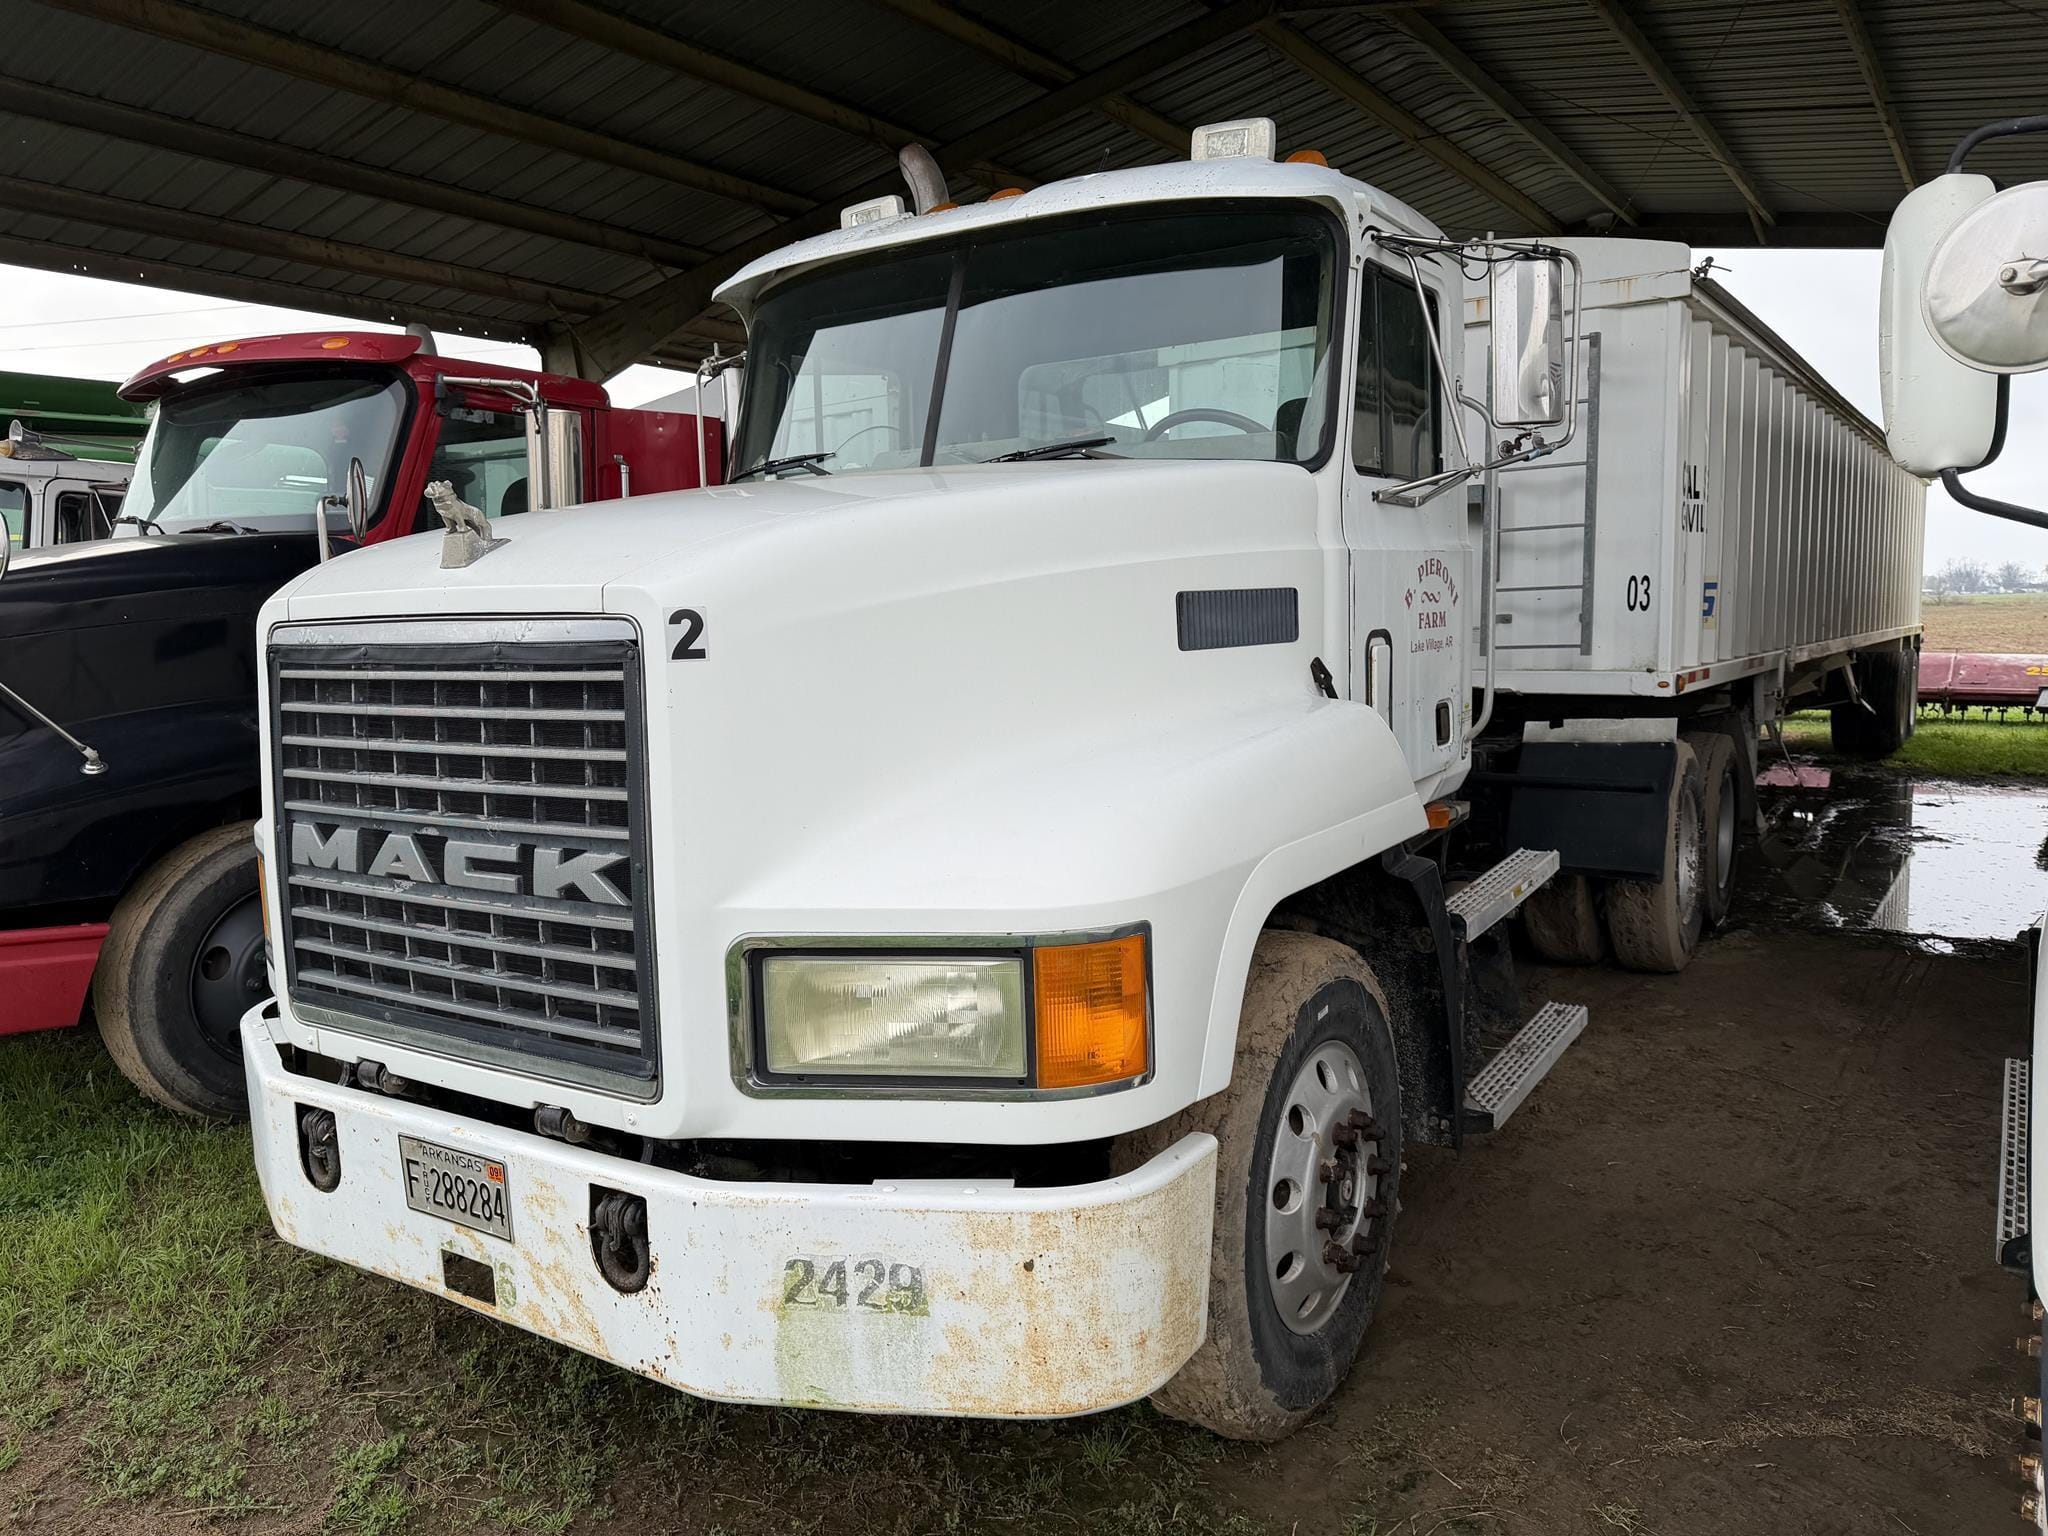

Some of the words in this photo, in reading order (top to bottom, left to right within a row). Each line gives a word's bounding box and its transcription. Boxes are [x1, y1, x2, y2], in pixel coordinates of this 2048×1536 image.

[1418, 558, 1458, 607] PIERONI
[1627, 574, 1650, 612] 03
[668, 609, 707, 660] 2
[1411, 639, 1424, 653] Lake
[1445, 635, 1454, 649] AR
[1418, 611, 1446, 629] FARM
[291, 821, 632, 906] MACK
[422, 1145, 482, 1173] ARKANSAS
[406, 1158, 419, 1198] F
[430, 1167, 505, 1227] 288284
[783, 1258, 924, 1310] 2429
